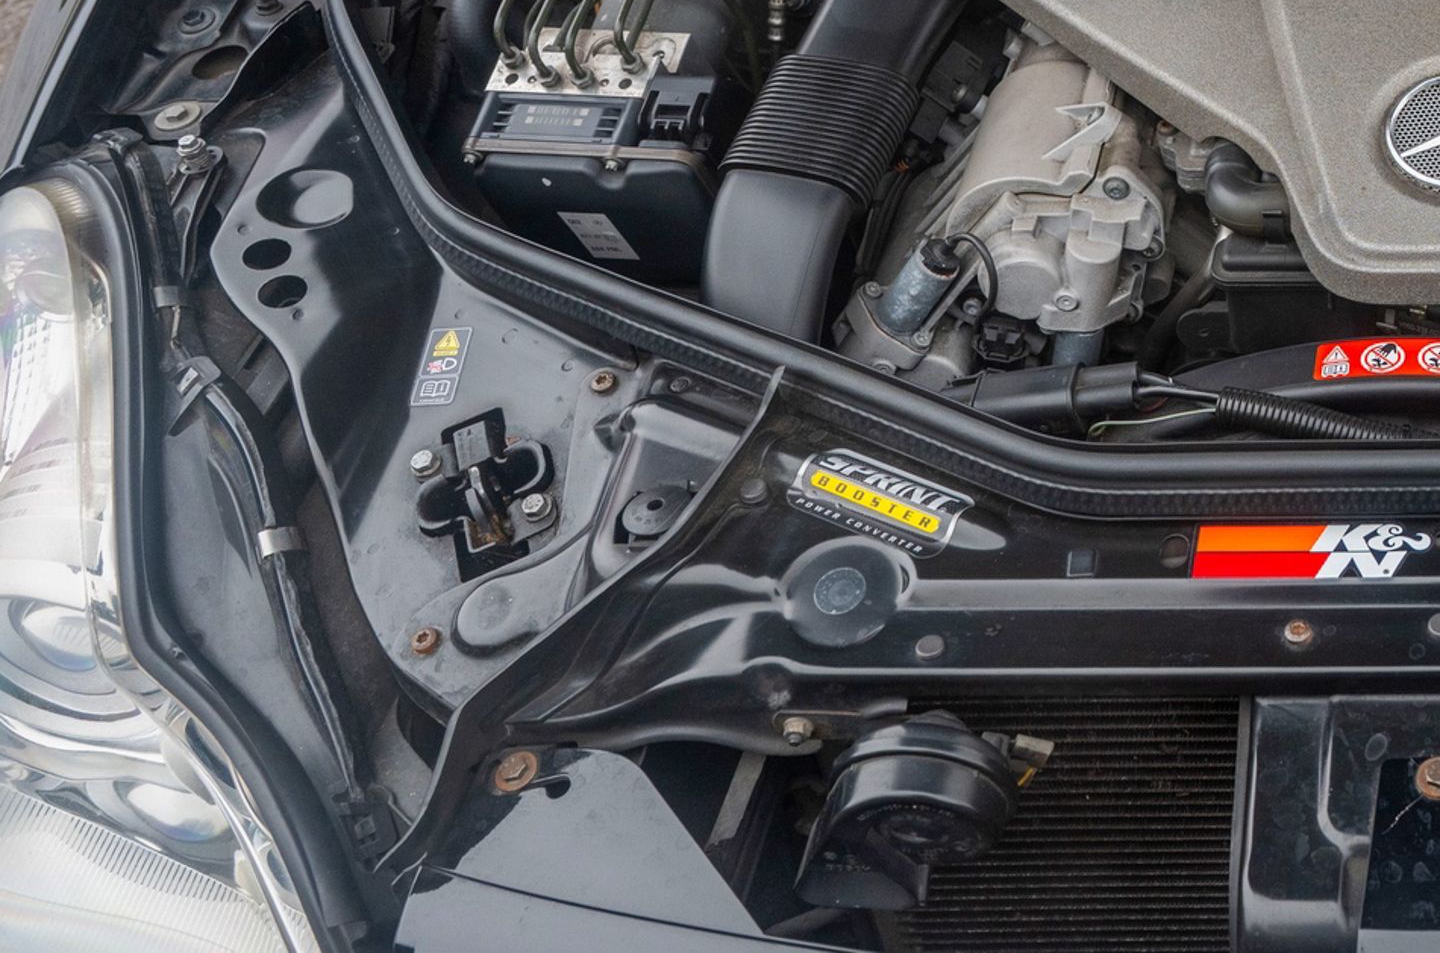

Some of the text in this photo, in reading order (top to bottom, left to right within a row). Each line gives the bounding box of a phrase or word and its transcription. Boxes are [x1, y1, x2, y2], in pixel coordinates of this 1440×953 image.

[817, 475, 932, 528] BOOSTER
[819, 456, 961, 511] SPRINT
[795, 497, 840, 520] POWER
[846, 517, 924, 553] CONVERTER
